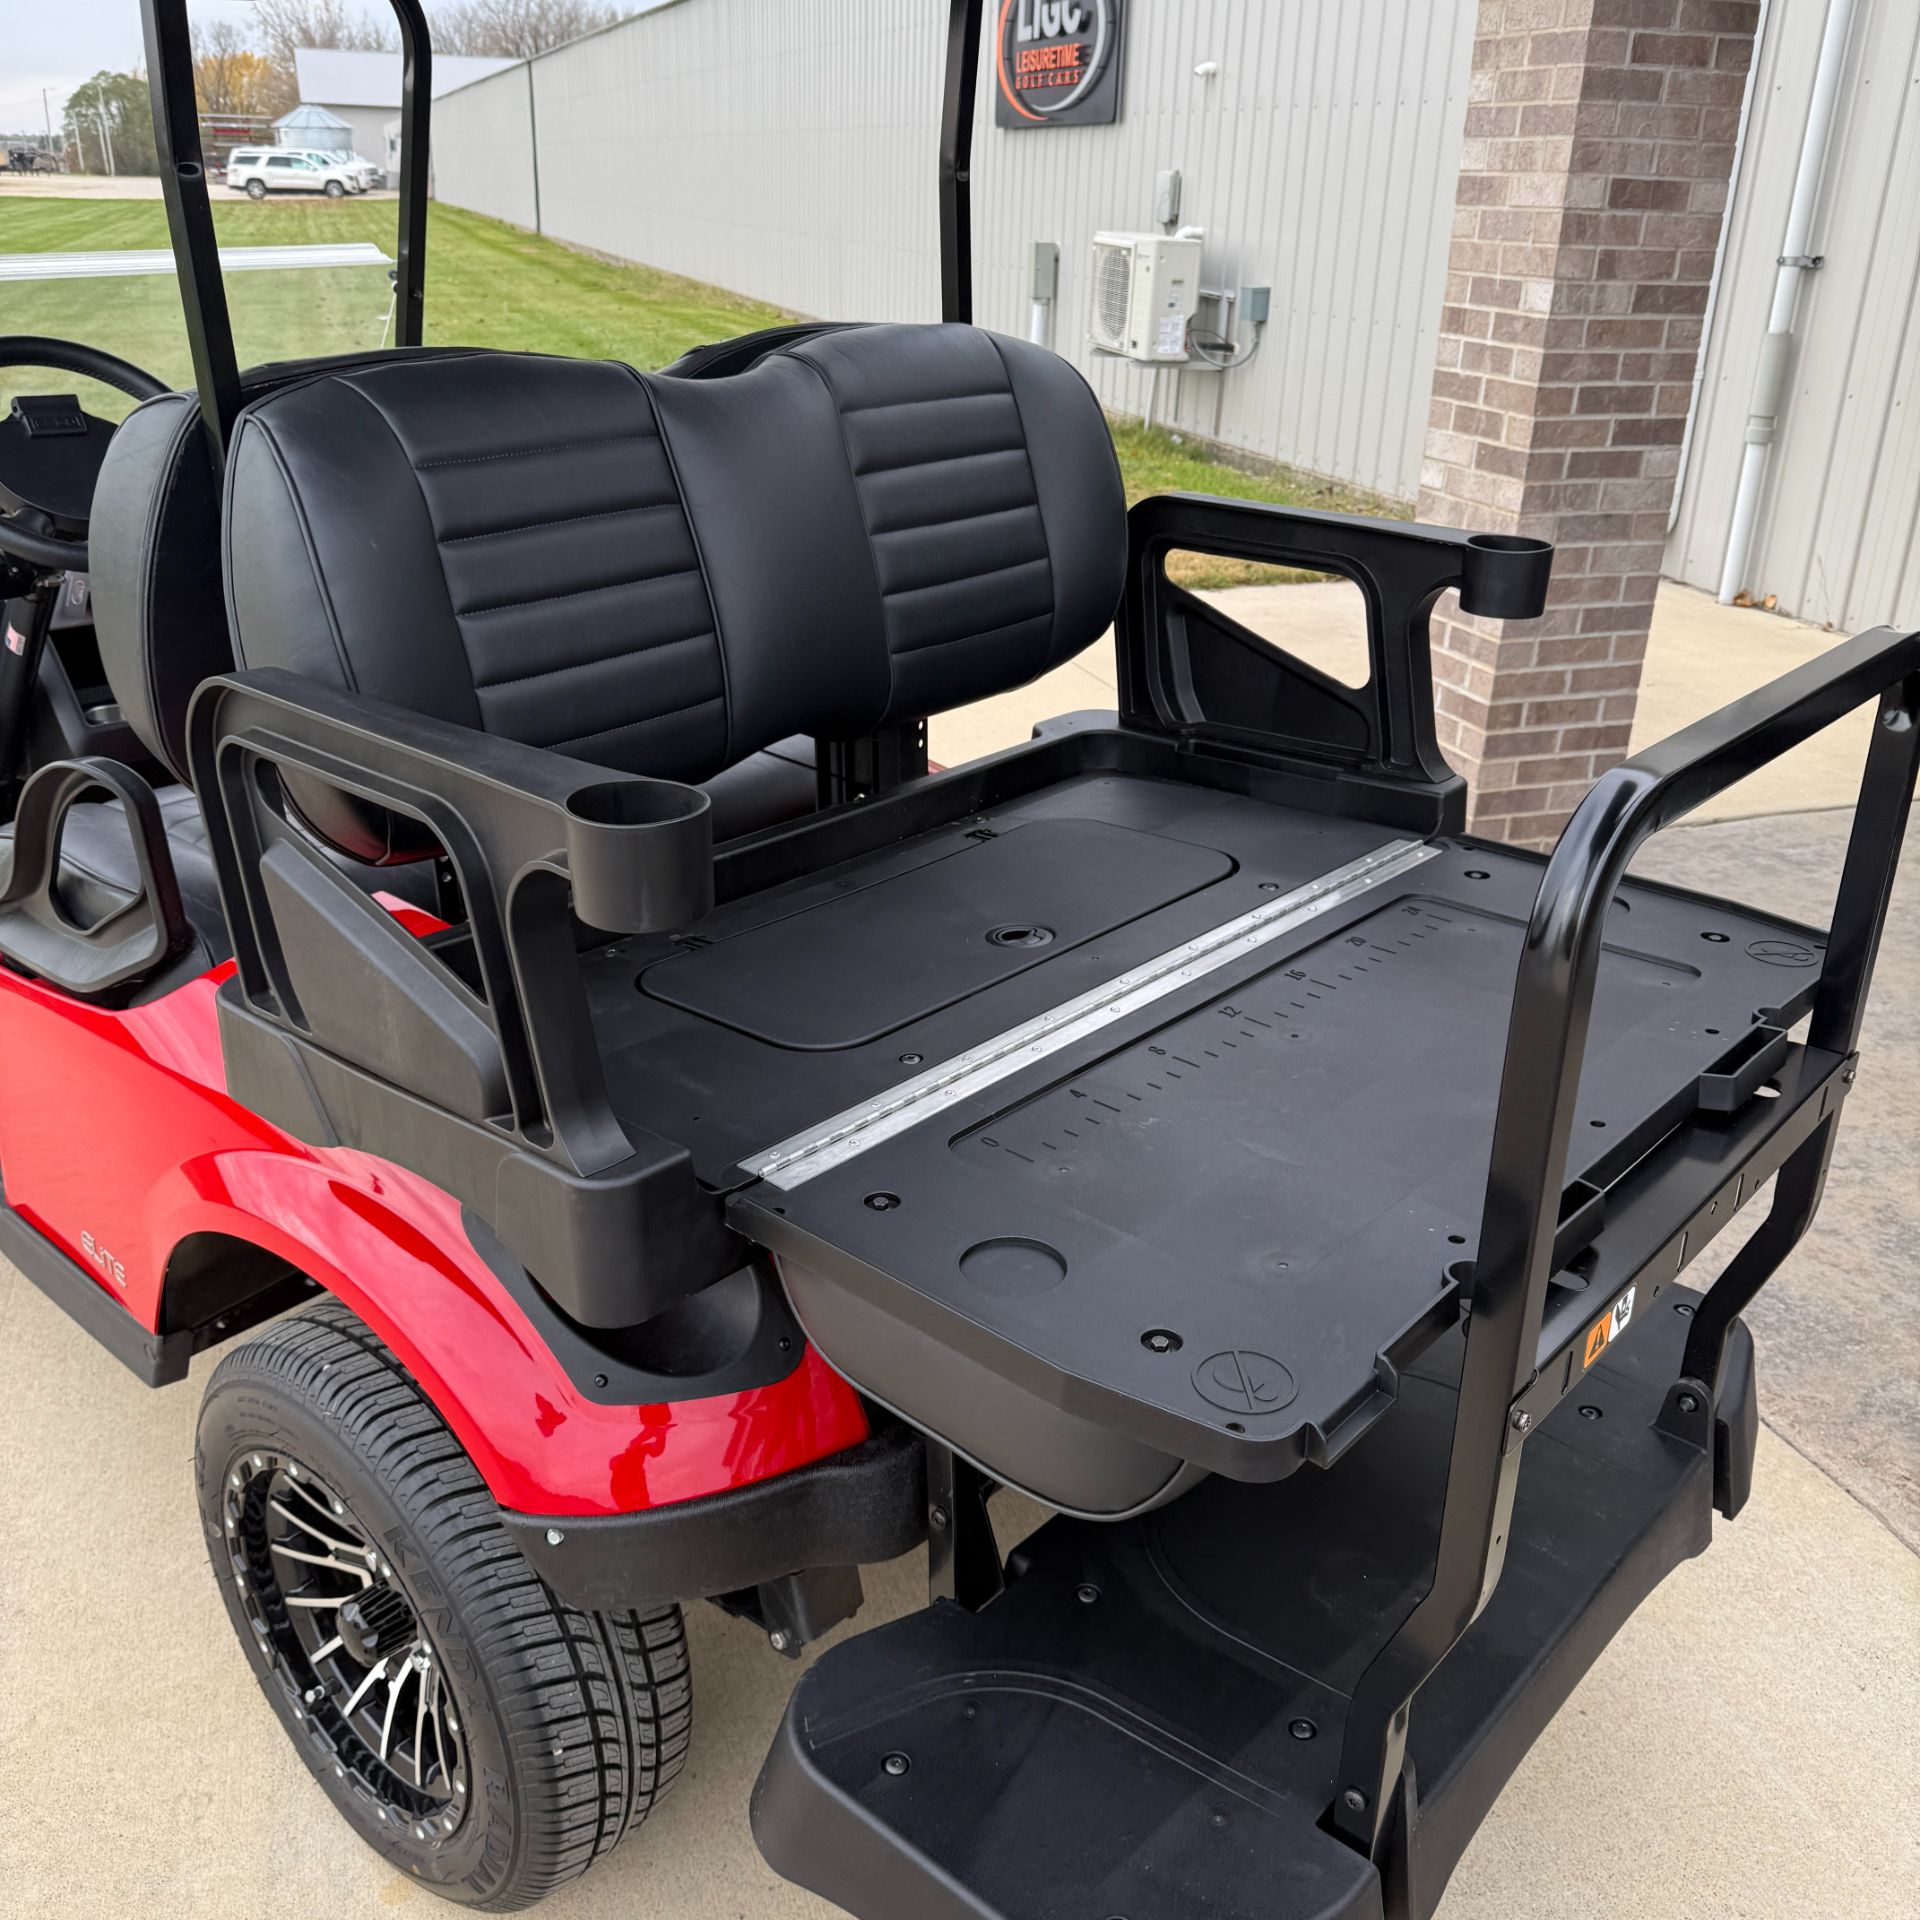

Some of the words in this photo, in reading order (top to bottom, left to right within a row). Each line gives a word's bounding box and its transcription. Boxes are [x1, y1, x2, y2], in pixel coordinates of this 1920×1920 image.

[1015, 43, 1082, 73] LEISURETIME
[1015, 73, 1044, 90] GOLF
[1047, 69, 1080, 87] CARS
[1069, 1088, 1087, 1098] 4
[1148, 1045, 1167, 1056] 8
[1217, 1005, 1242, 1019] 12
[1284, 969, 1307, 981] 16
[1344, 935, 1367, 947] 20
[1401, 905, 1423, 916] 24
[382, 1525, 493, 1718] KENDA
